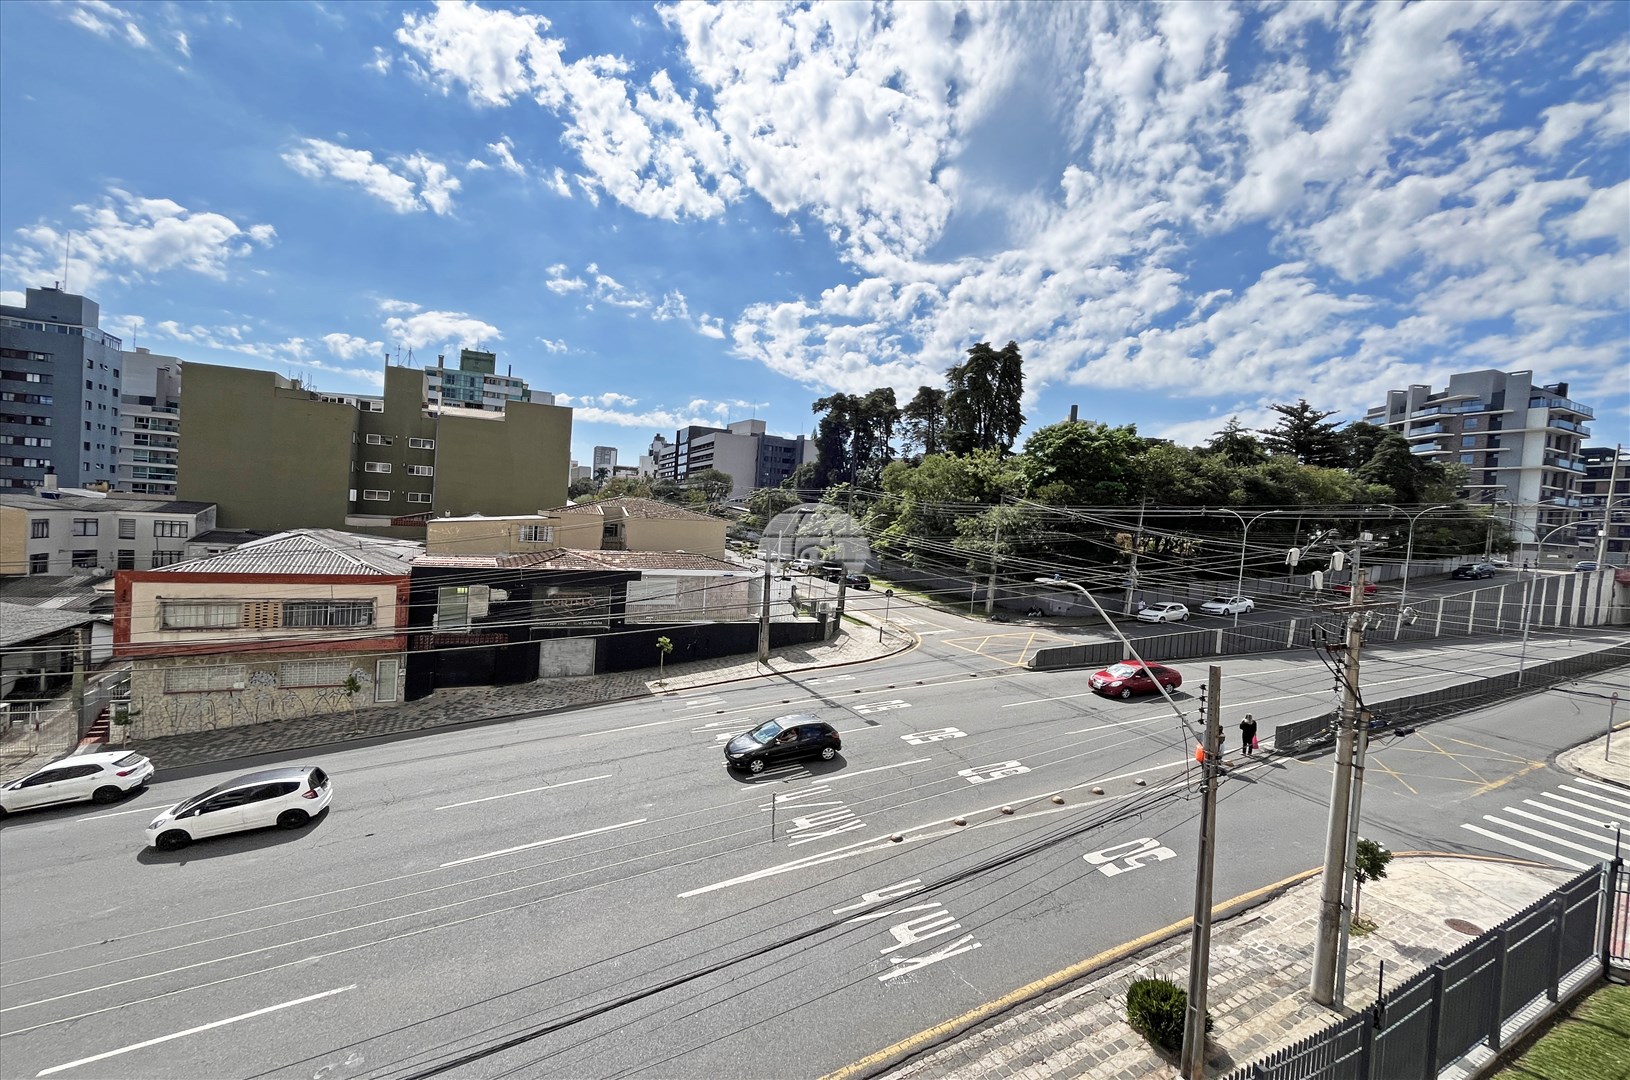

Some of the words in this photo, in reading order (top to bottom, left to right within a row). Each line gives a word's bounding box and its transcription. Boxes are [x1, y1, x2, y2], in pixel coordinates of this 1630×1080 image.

[852, 699, 912, 714] 50
[900, 727, 968, 746] 50
[957, 760, 1032, 785] 50
[1083, 837, 1178, 878] 50
